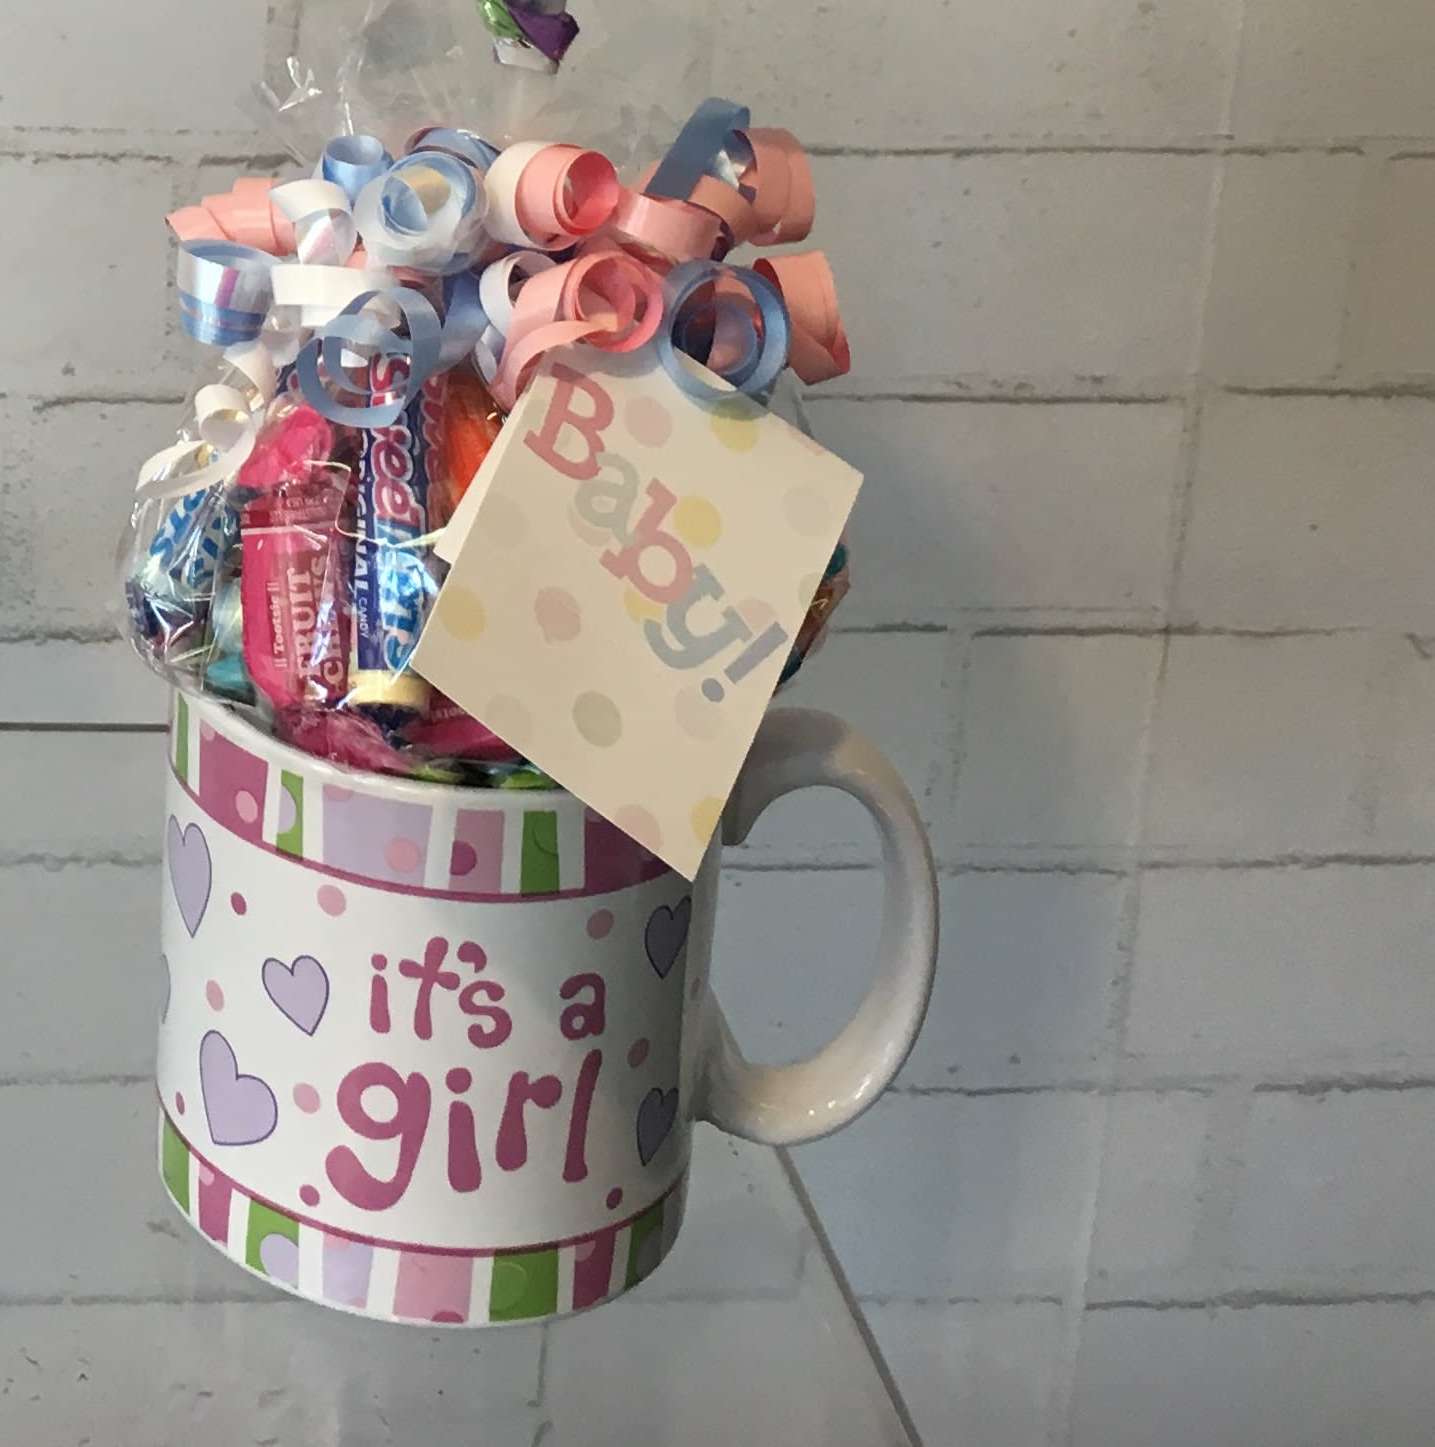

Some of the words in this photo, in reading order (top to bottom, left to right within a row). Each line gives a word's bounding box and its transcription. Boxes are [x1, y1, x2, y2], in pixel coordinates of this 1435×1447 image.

[523, 361, 789, 704] Baby!
[269, 596, 285, 655] Tootsie
[287, 567, 322, 679] FRUIT
[357, 597, 370, 638] CANDY
[368, 936, 513, 1049] it's
[558, 972, 606, 1041] a
[324, 1049, 603, 1212] girl
